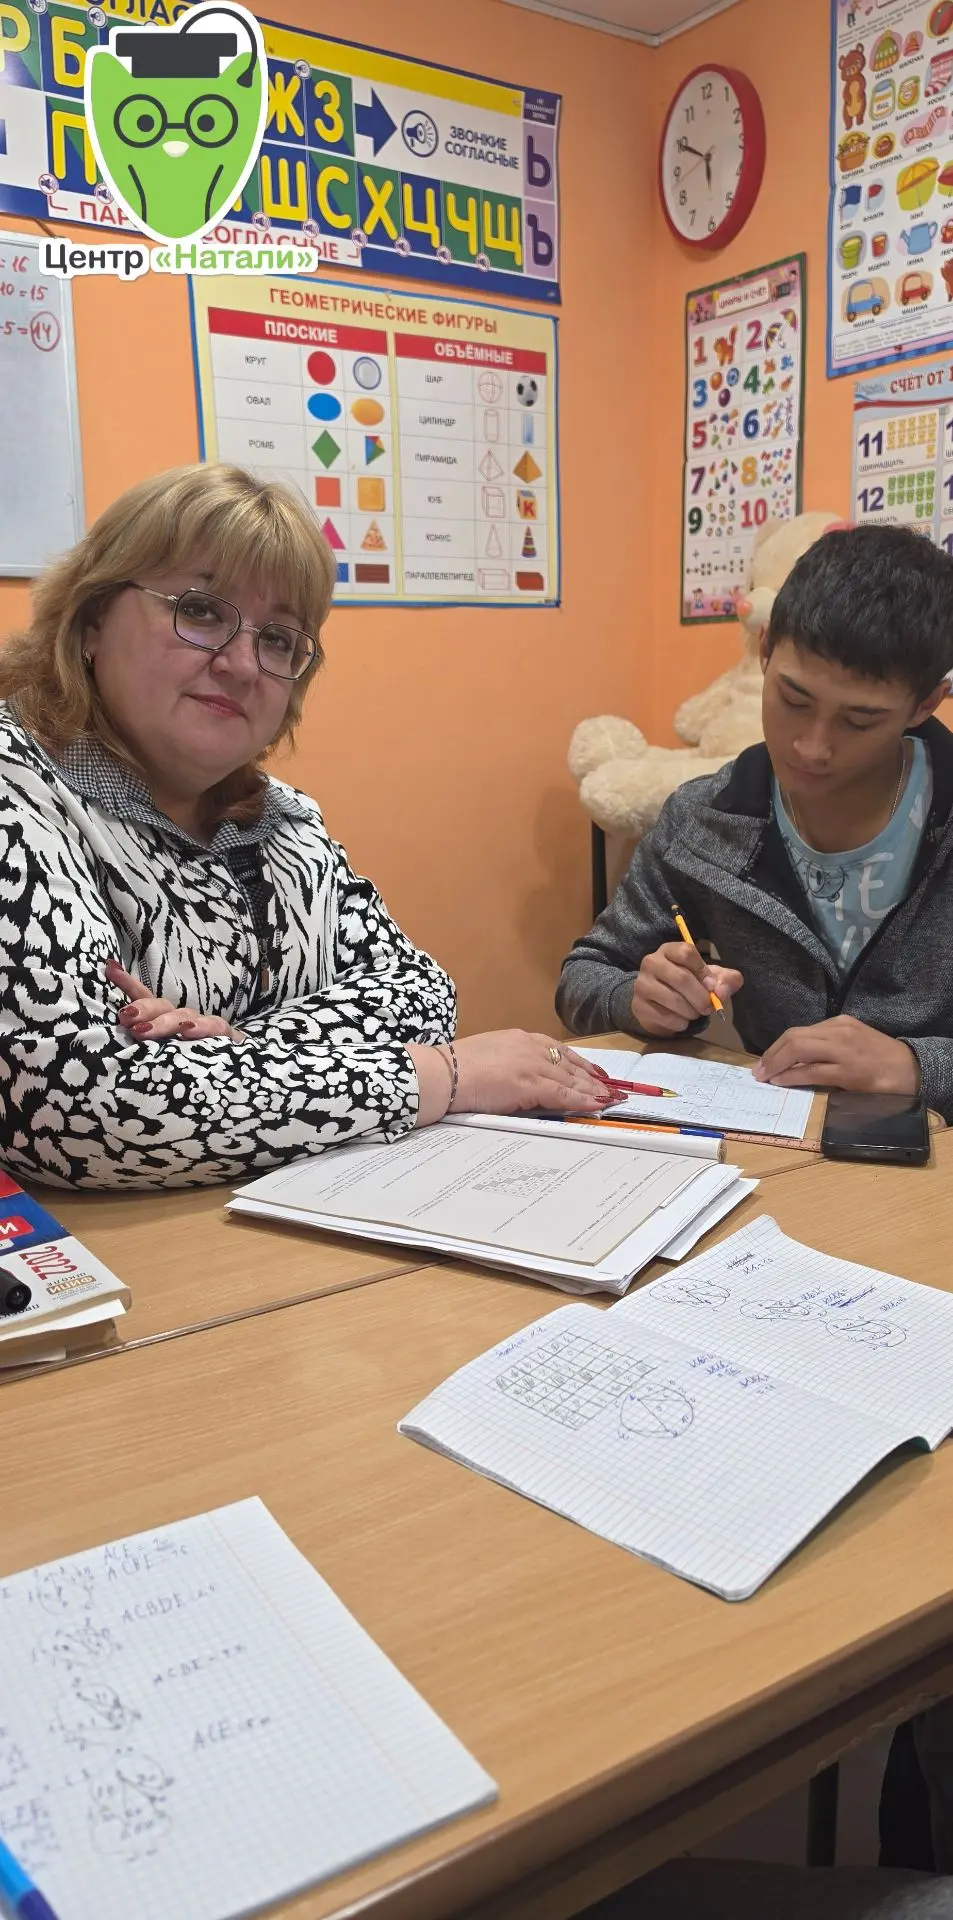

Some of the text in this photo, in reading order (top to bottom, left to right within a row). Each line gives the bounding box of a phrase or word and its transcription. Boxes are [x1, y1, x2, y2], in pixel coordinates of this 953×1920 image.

[51, 15, 88, 88] Б
[701, 82, 713, 100] 12
[724, 86, 729, 102] 1
[266, 71, 345, 143] Ж З
[684, 105, 694, 123] 11
[733, 107, 741, 124] 2
[449, 125, 507, 151] ЗВОНКИЕ
[675, 136, 688, 154] 10
[444, 141, 520, 170] СОГЛАСНЫЕ
[527, 135, 551, 187] Ь
[673, 166, 681, 181] 9
[52, 111, 523, 265] П Ш С Х Ц Ч Щ
[679, 190, 687, 206] 8
[725, 192, 733, 209] 5
[689, 209, 696, 226] 7
[708, 215, 716, 232] 6
[12, 255, 30, 273] 16
[31, 285, 48, 301] 15
[269, 287, 498, 334] ГЕОМЕТРИЧЕСКИЕ ФИГУРЫ
[264, 319, 338, 343] ПЛОСКИЕ
[745, 319, 762, 351] 2
[245, 355, 268, 365] КРУГ
[434, 342, 513, 365] ОБЪЁМНЫЕ
[693, 335, 708, 367] 1
[425, 374, 443, 383] ШАР
[743, 364, 761, 395] 4
[927, 370, 944, 386] ОТ
[246, 395, 271, 406] ОВАЛ
[692, 378, 708, 409] 3
[419, 415, 456, 427] ЦИЛИНДР
[742, 408, 760, 439] 6
[692, 420, 707, 449] 5
[248, 438, 275, 450] РОМБ
[858, 430, 883, 459] 11
[414, 453, 458, 465] ПИРАМИДА
[740, 456, 757, 486] 8
[690, 466, 706, 496] 7
[427, 495, 443, 504] КУБ
[857, 486, 884, 513] 12
[688, 506, 703, 535] 9
[740, 498, 767, 529] 10
[425, 533, 451, 543] КОНУС
[404, 570, 474, 582] ПАРАЛЛЕЛЕПИПЕД
[19, 1246, 78, 1281] 2022
[49, 1276, 93, 1293] ФИПИ
